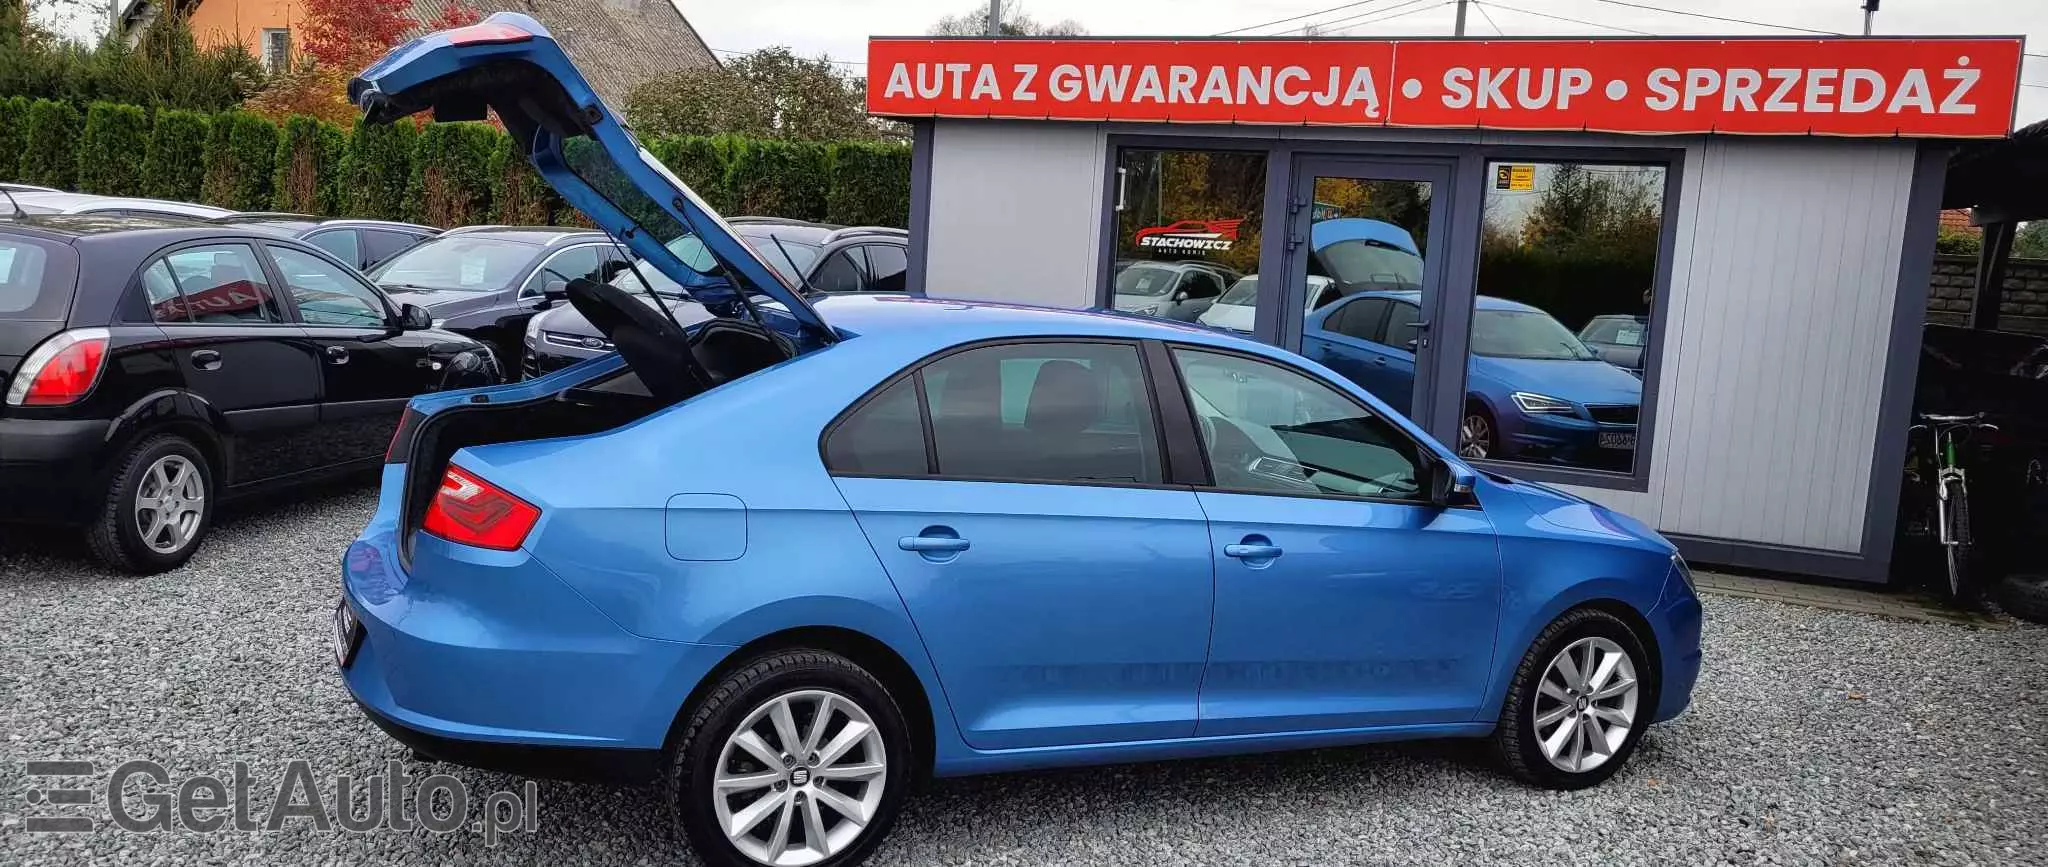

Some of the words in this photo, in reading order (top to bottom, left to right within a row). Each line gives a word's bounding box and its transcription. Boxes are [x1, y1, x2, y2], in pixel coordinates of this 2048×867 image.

[884, 62, 1002, 101] AUTA
[1012, 63, 1038, 101] Z
[1048, 63, 1380, 118] GWARANCJĄ
[1440, 67, 1593, 110] SKUP
[1644, 55, 1981, 115] SPRZEDAŻ
[1140, 236, 1232, 250] STACHOWICZ
